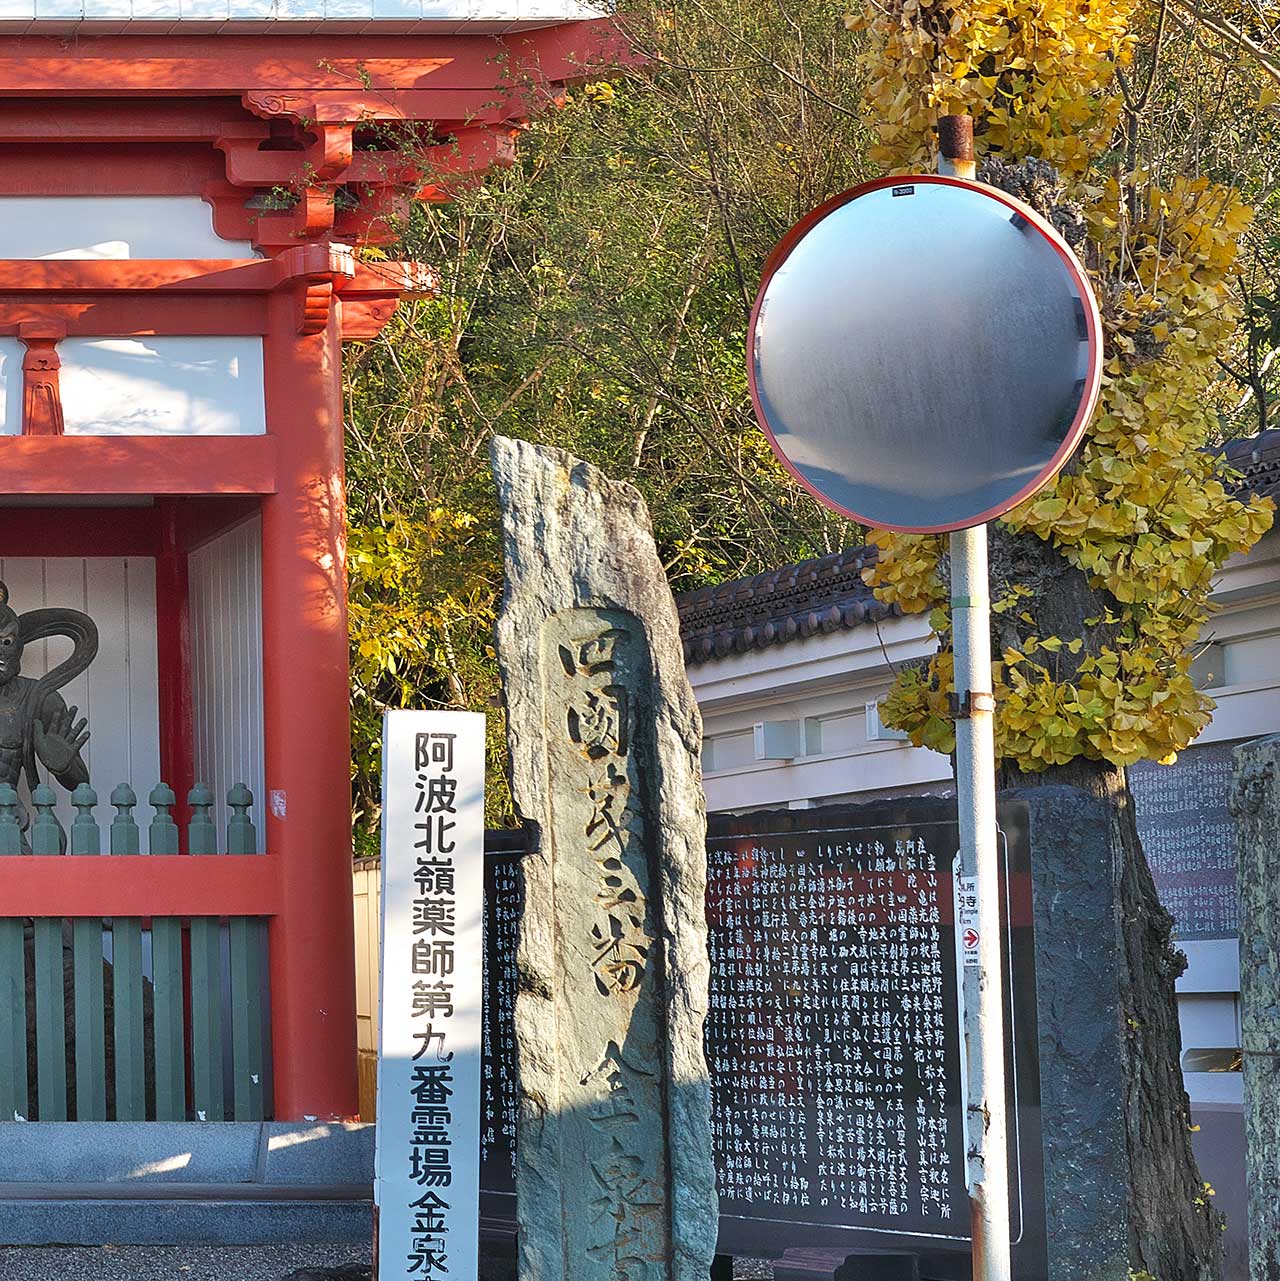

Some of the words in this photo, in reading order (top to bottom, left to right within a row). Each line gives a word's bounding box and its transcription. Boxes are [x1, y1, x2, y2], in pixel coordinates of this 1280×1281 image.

[406, 731, 457, 1281] 阿波北嶺薬師第九番霊場金泉
